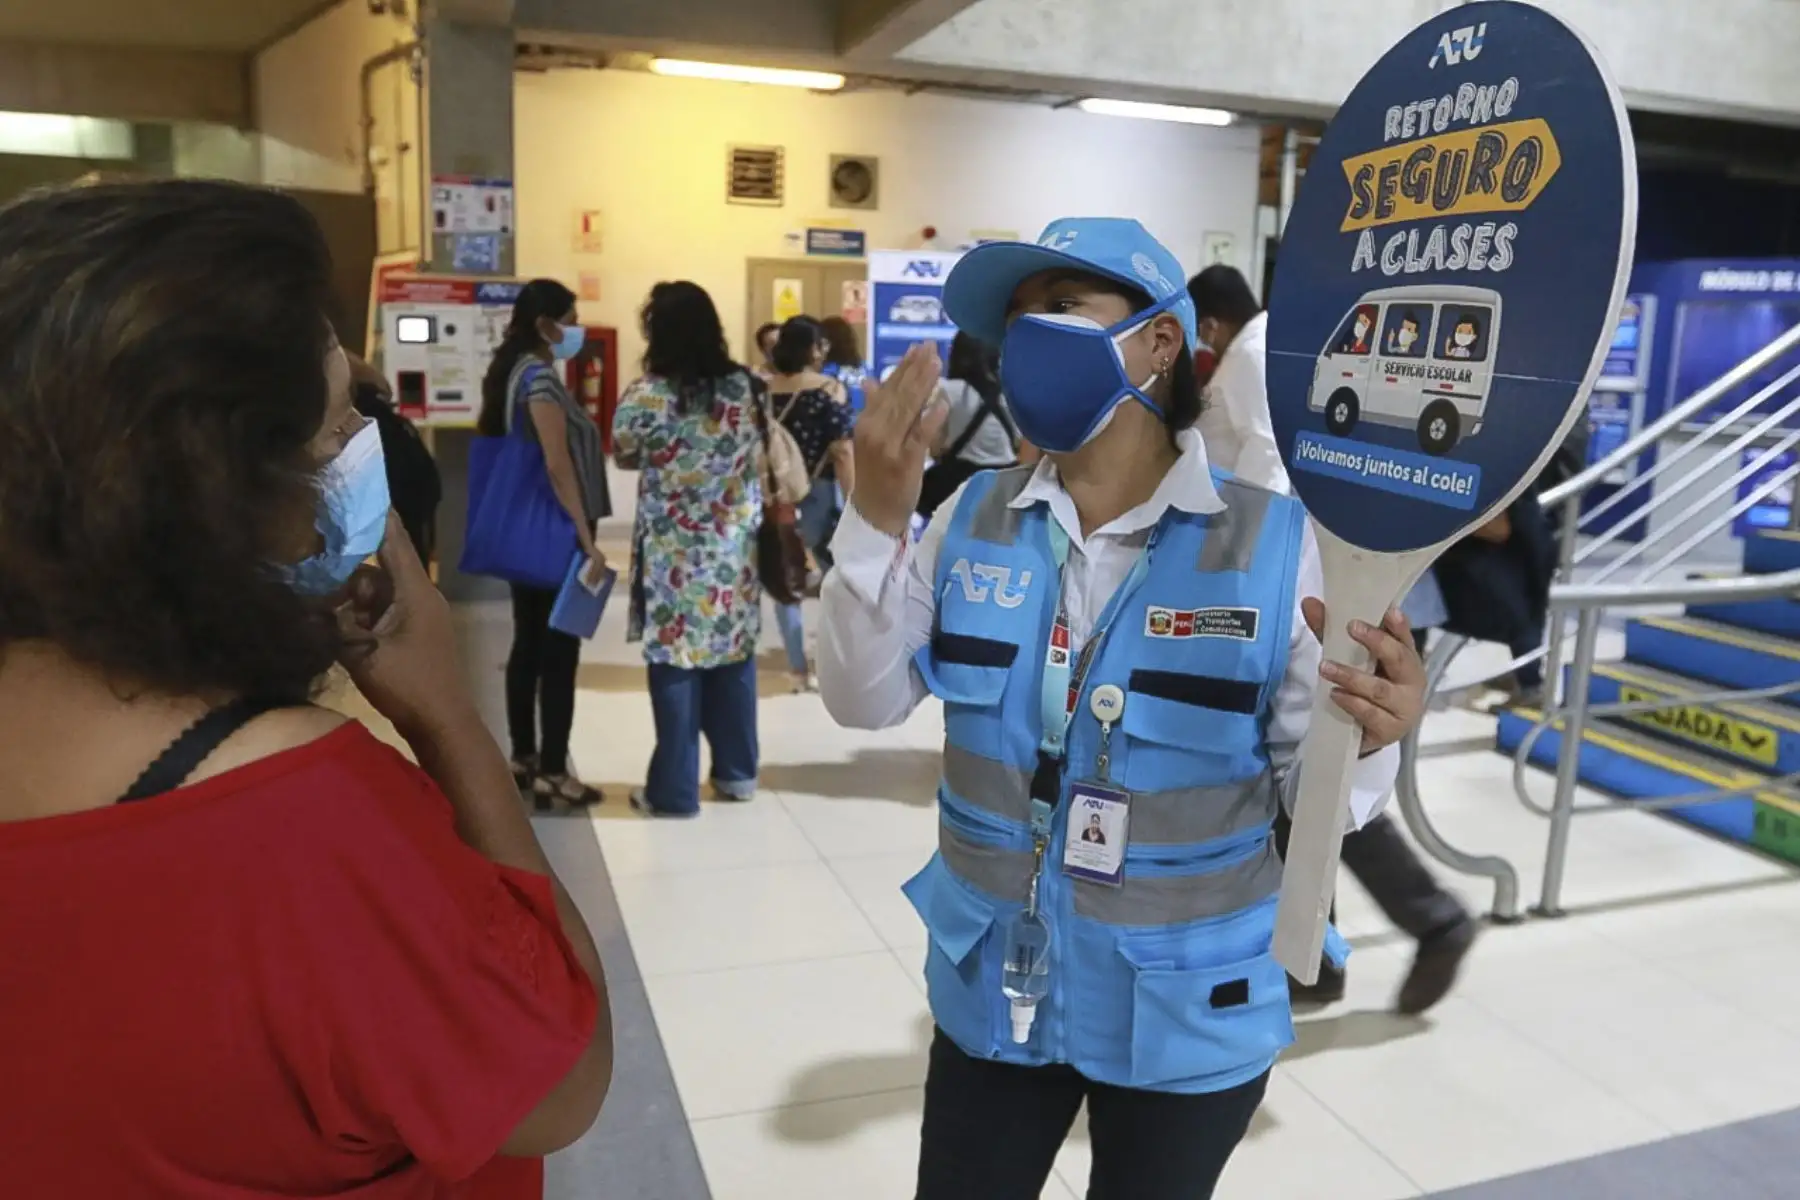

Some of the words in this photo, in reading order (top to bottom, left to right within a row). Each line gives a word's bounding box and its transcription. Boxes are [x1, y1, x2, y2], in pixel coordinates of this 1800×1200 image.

[1428, 22, 1487, 69] ATU
[1384, 76, 1519, 142] RETORNO
[1350, 130, 1543, 220] SEGURO
[1351, 226, 1376, 273] A
[1380, 221, 1518, 276] CLASES
[1384, 361, 1426, 378] SERVICIO
[1427, 365, 1472, 383] ESCOLAR
[1296, 439, 1362, 471] ¡Volvamos
[1362, 454, 1410, 480] juntos
[1412, 466, 1429, 486] al
[1430, 472, 1473, 495] cole!
[942, 557, 1031, 608] ATU
